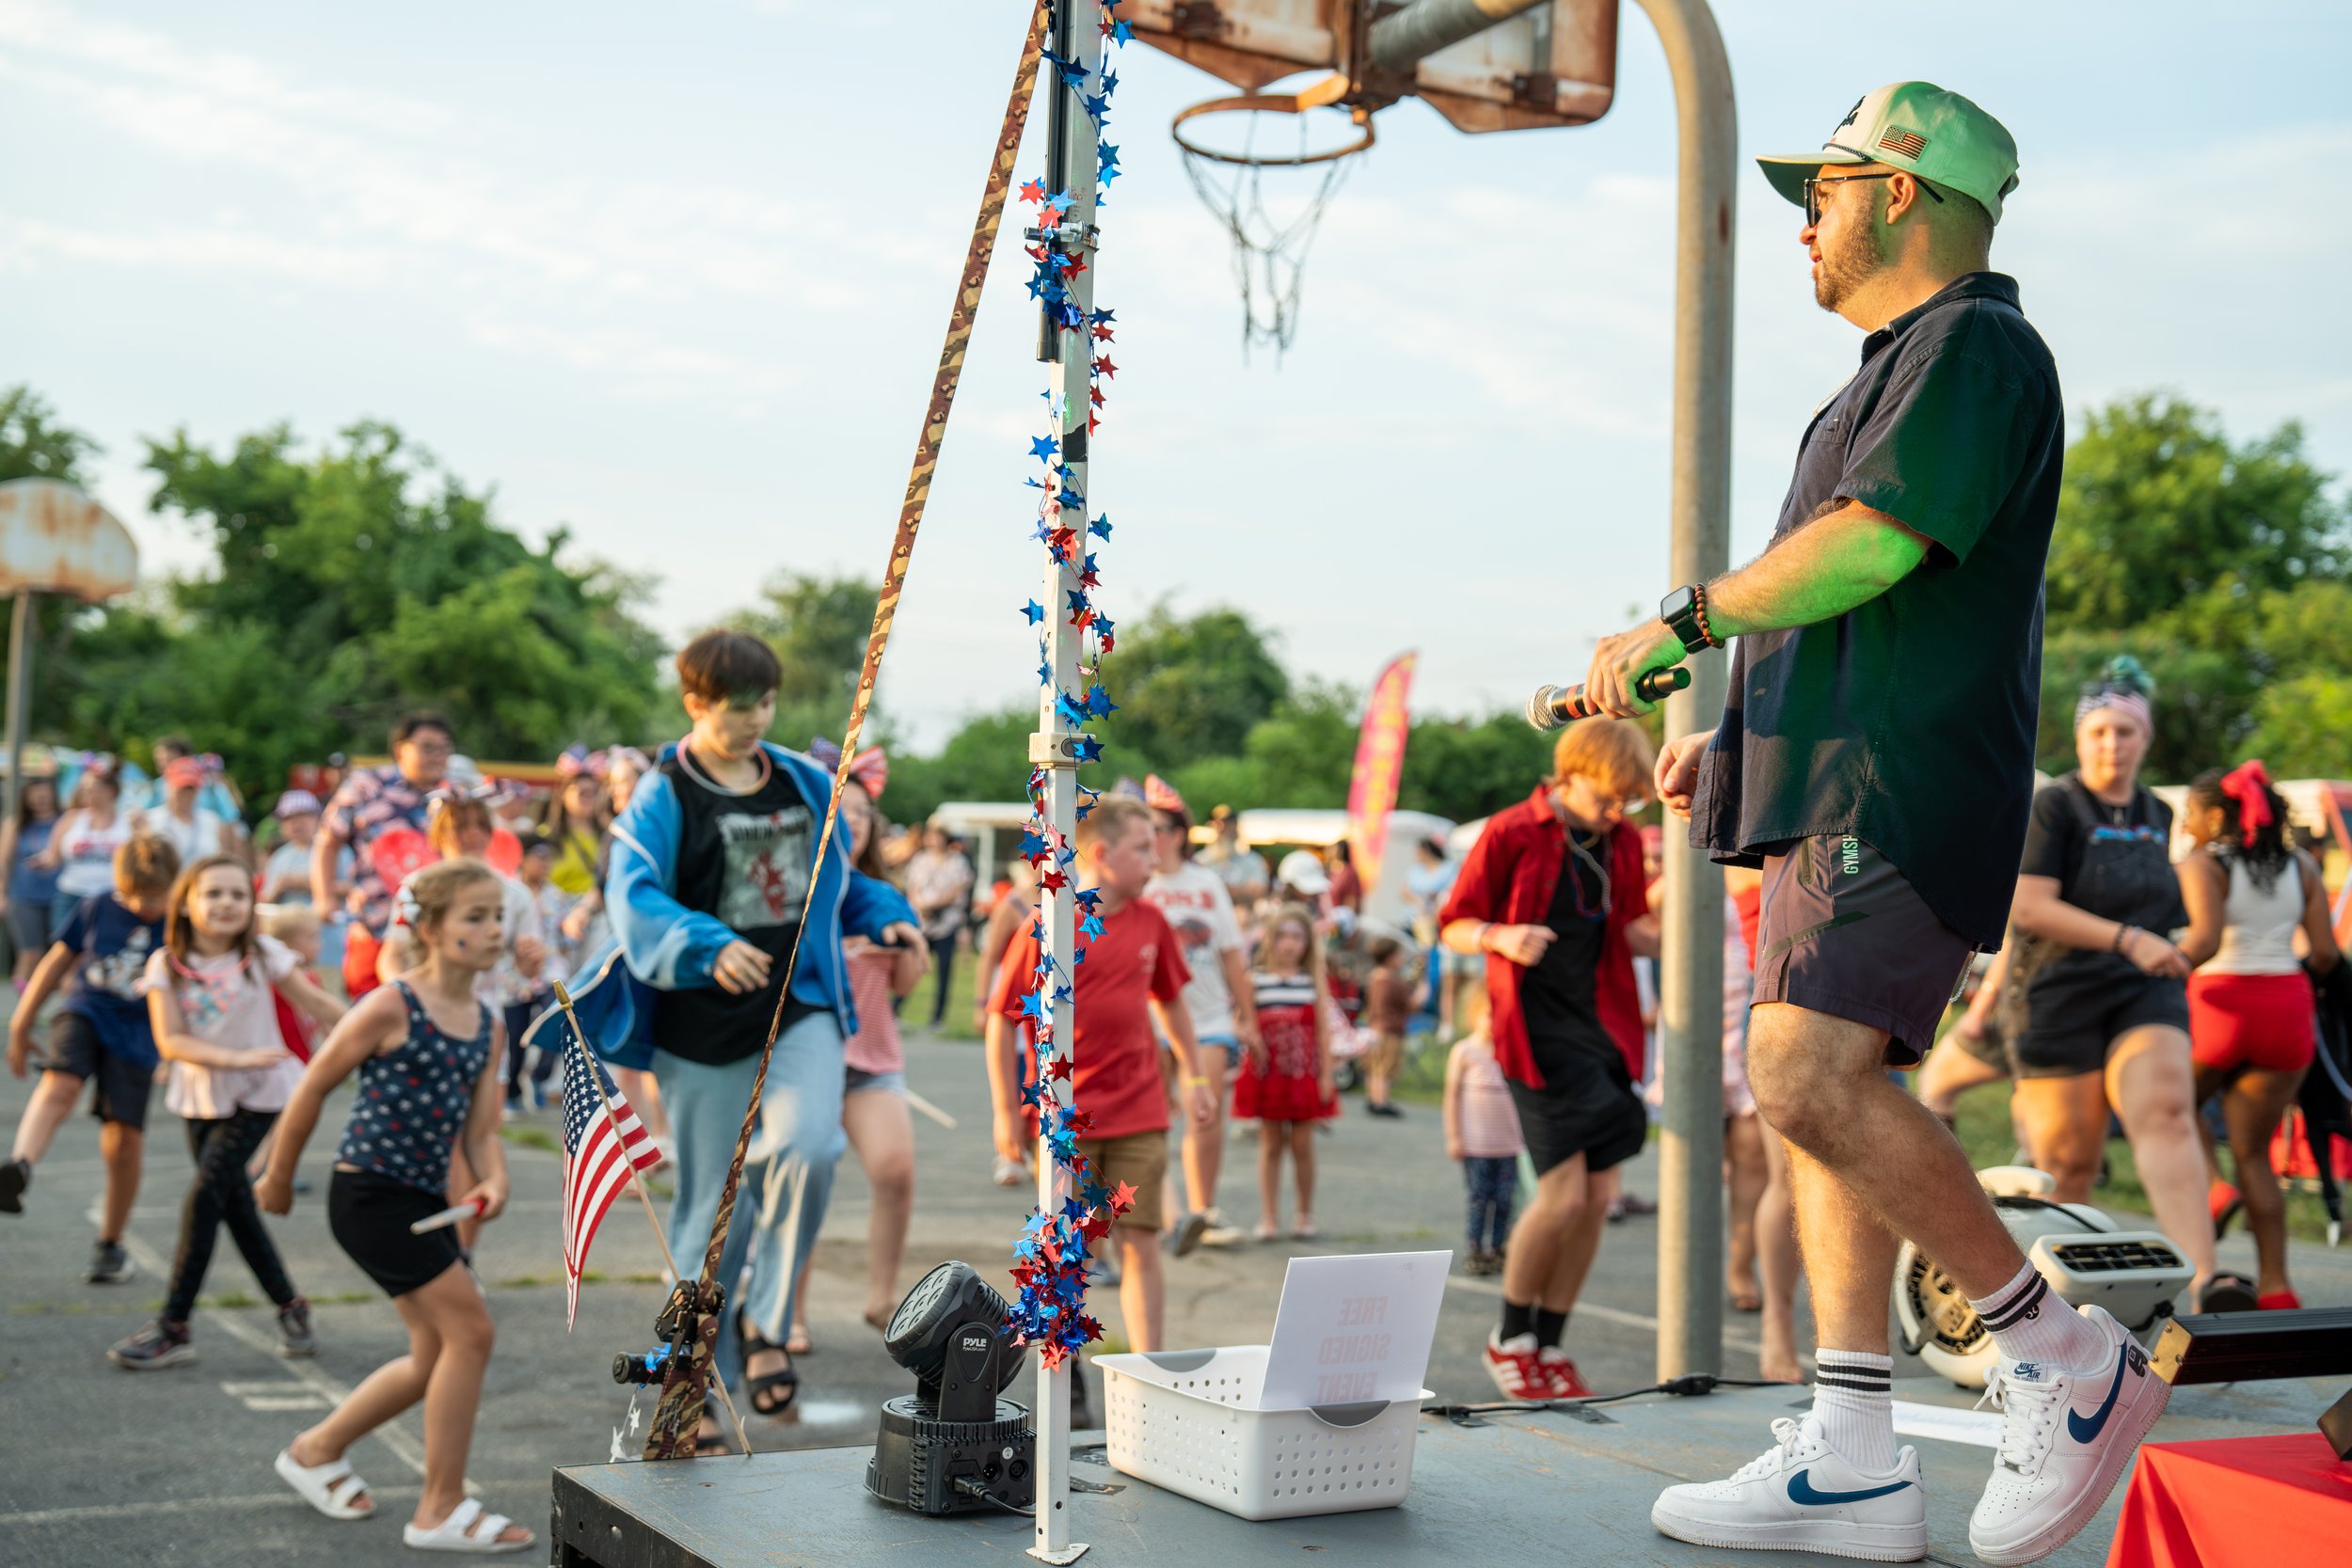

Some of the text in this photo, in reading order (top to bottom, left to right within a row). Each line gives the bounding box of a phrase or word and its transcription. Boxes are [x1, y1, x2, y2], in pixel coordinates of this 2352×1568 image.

[1842, 834, 1859, 875] GYMSH
[962, 1338, 987, 1347] PYLE
[2017, 1362, 2039, 1370] NIKE
